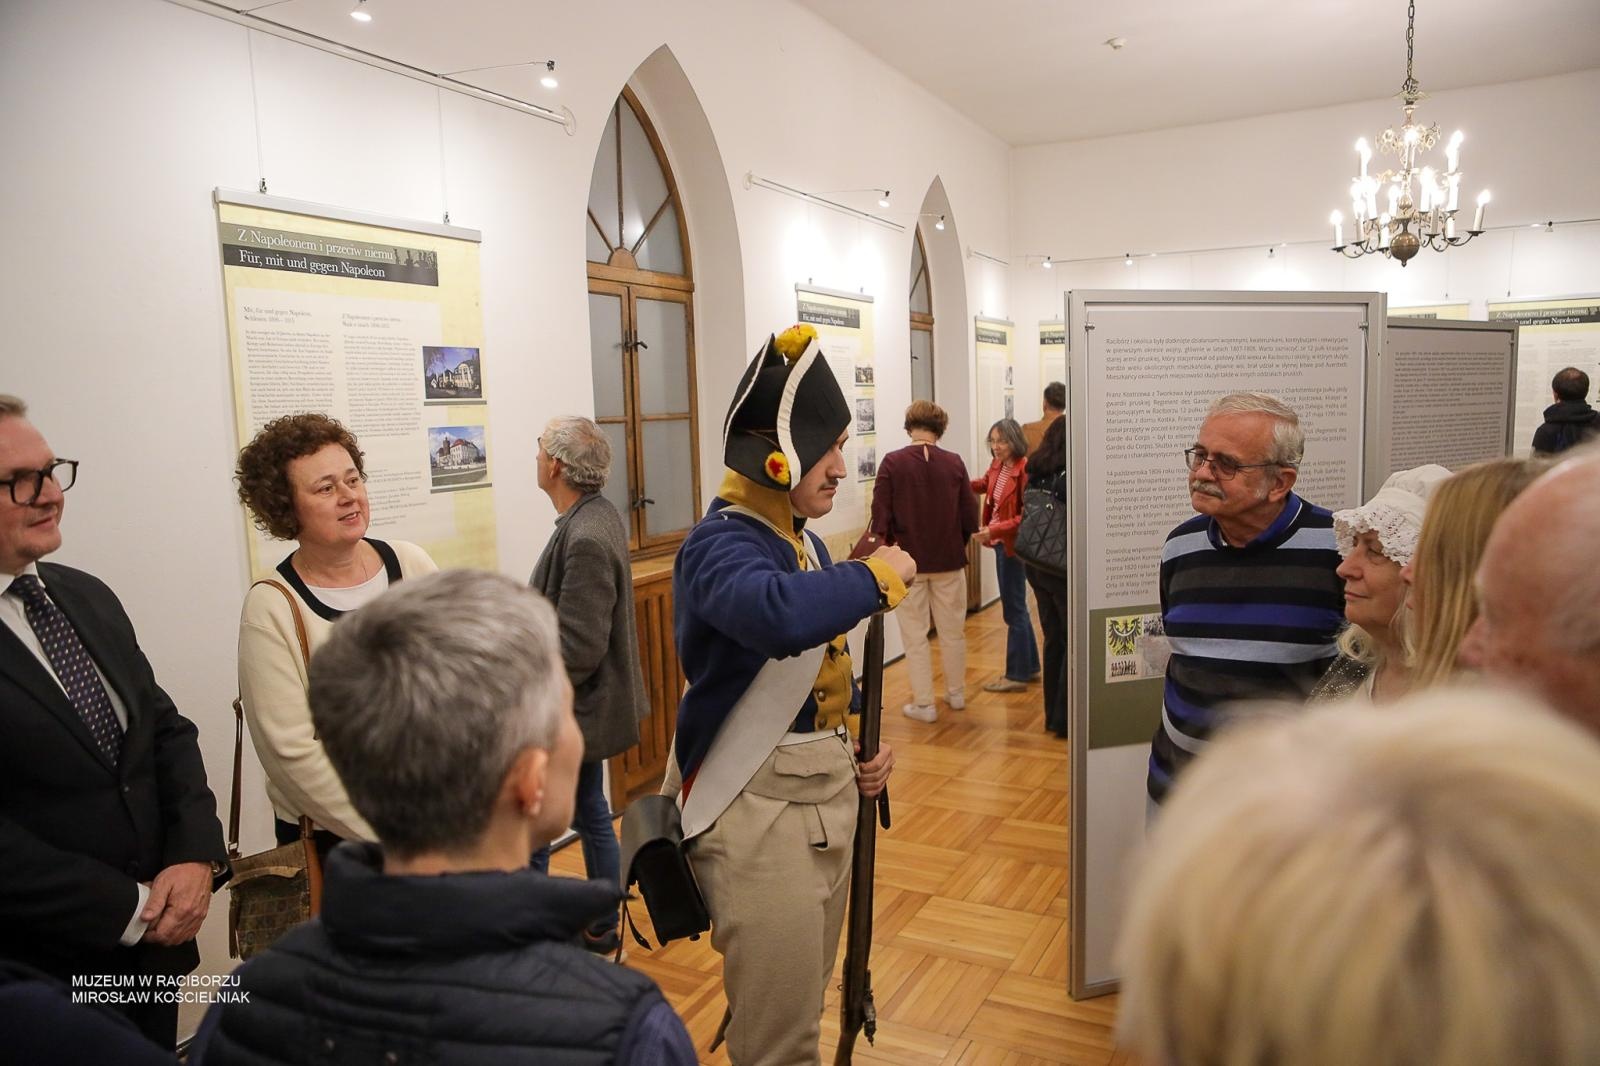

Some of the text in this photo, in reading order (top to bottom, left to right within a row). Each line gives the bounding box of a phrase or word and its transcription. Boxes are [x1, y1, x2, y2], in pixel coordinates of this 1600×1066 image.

[237, 229, 393, 260] Z Napoleonem i przeciw niemu
[239, 249, 385, 279] Für, mit und gegen Napoleon
